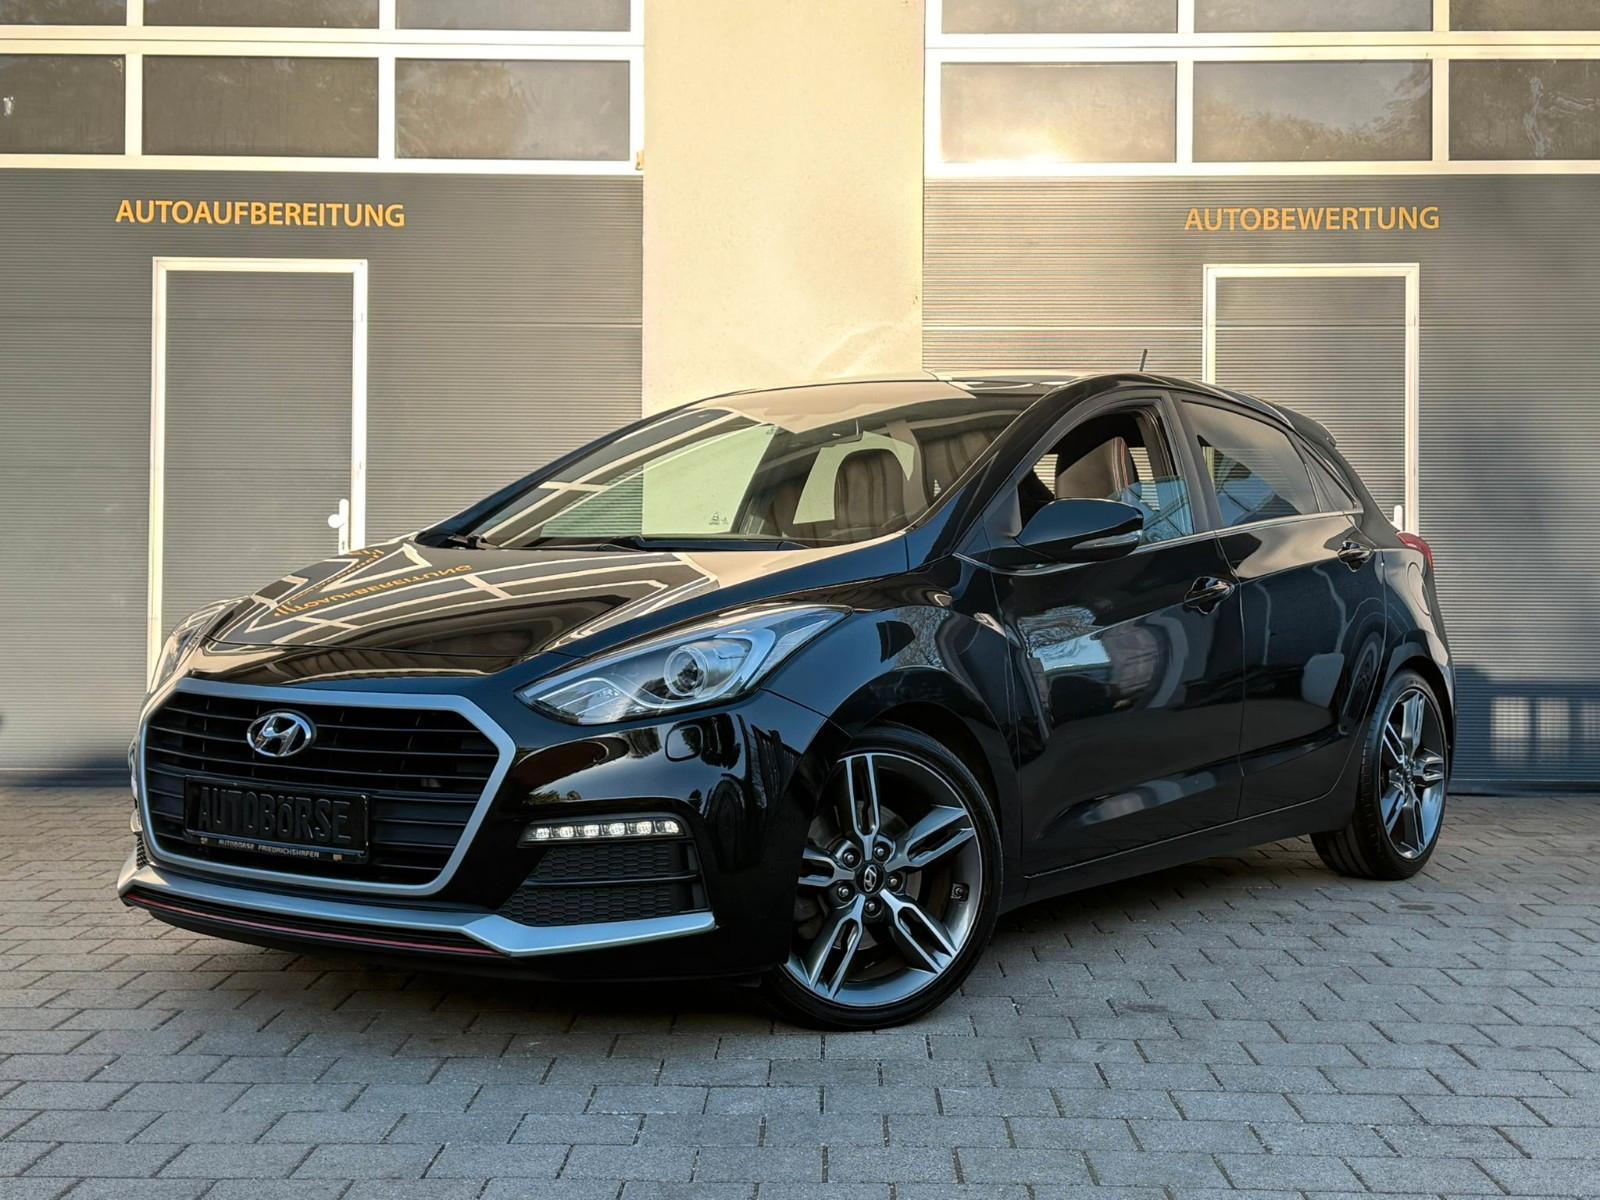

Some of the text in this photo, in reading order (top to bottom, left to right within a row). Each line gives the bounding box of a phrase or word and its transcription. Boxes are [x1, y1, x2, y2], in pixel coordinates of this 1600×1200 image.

[115, 199, 406, 228] AUTOAUFBEREITUNG
[1184, 206, 1441, 232] AUTOBEWERTUNG
[199, 786, 352, 840] AUTOBÖRSE
